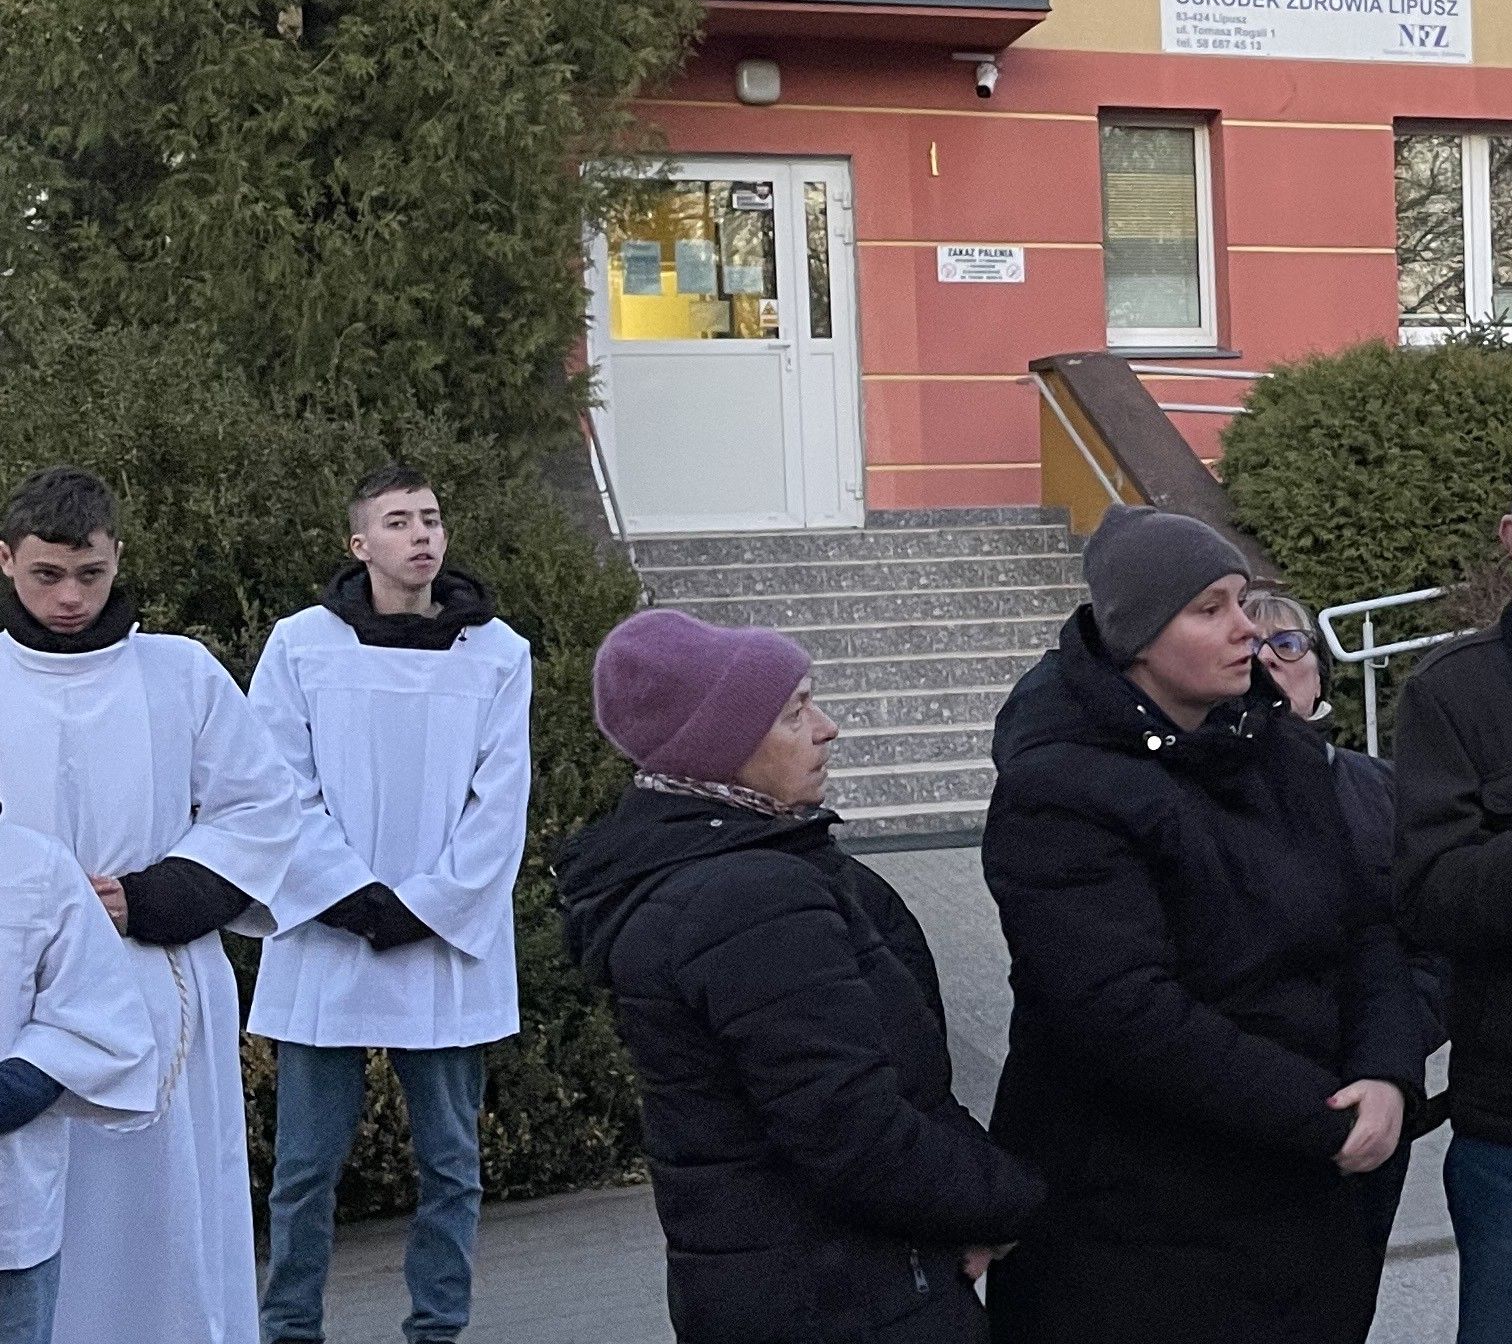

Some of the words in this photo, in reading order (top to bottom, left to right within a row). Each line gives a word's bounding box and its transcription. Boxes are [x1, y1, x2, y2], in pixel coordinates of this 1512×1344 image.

[1176, 11, 1210, 23] 83-424
[1212, 12, 1247, 26] Lipusz
[1176, 25, 1190, 35] ul.
[1398, 23, 1450, 48] NFZ
[947, 247, 975, 257] ZAKAZ
[978, 248, 1014, 258] PALENIA
